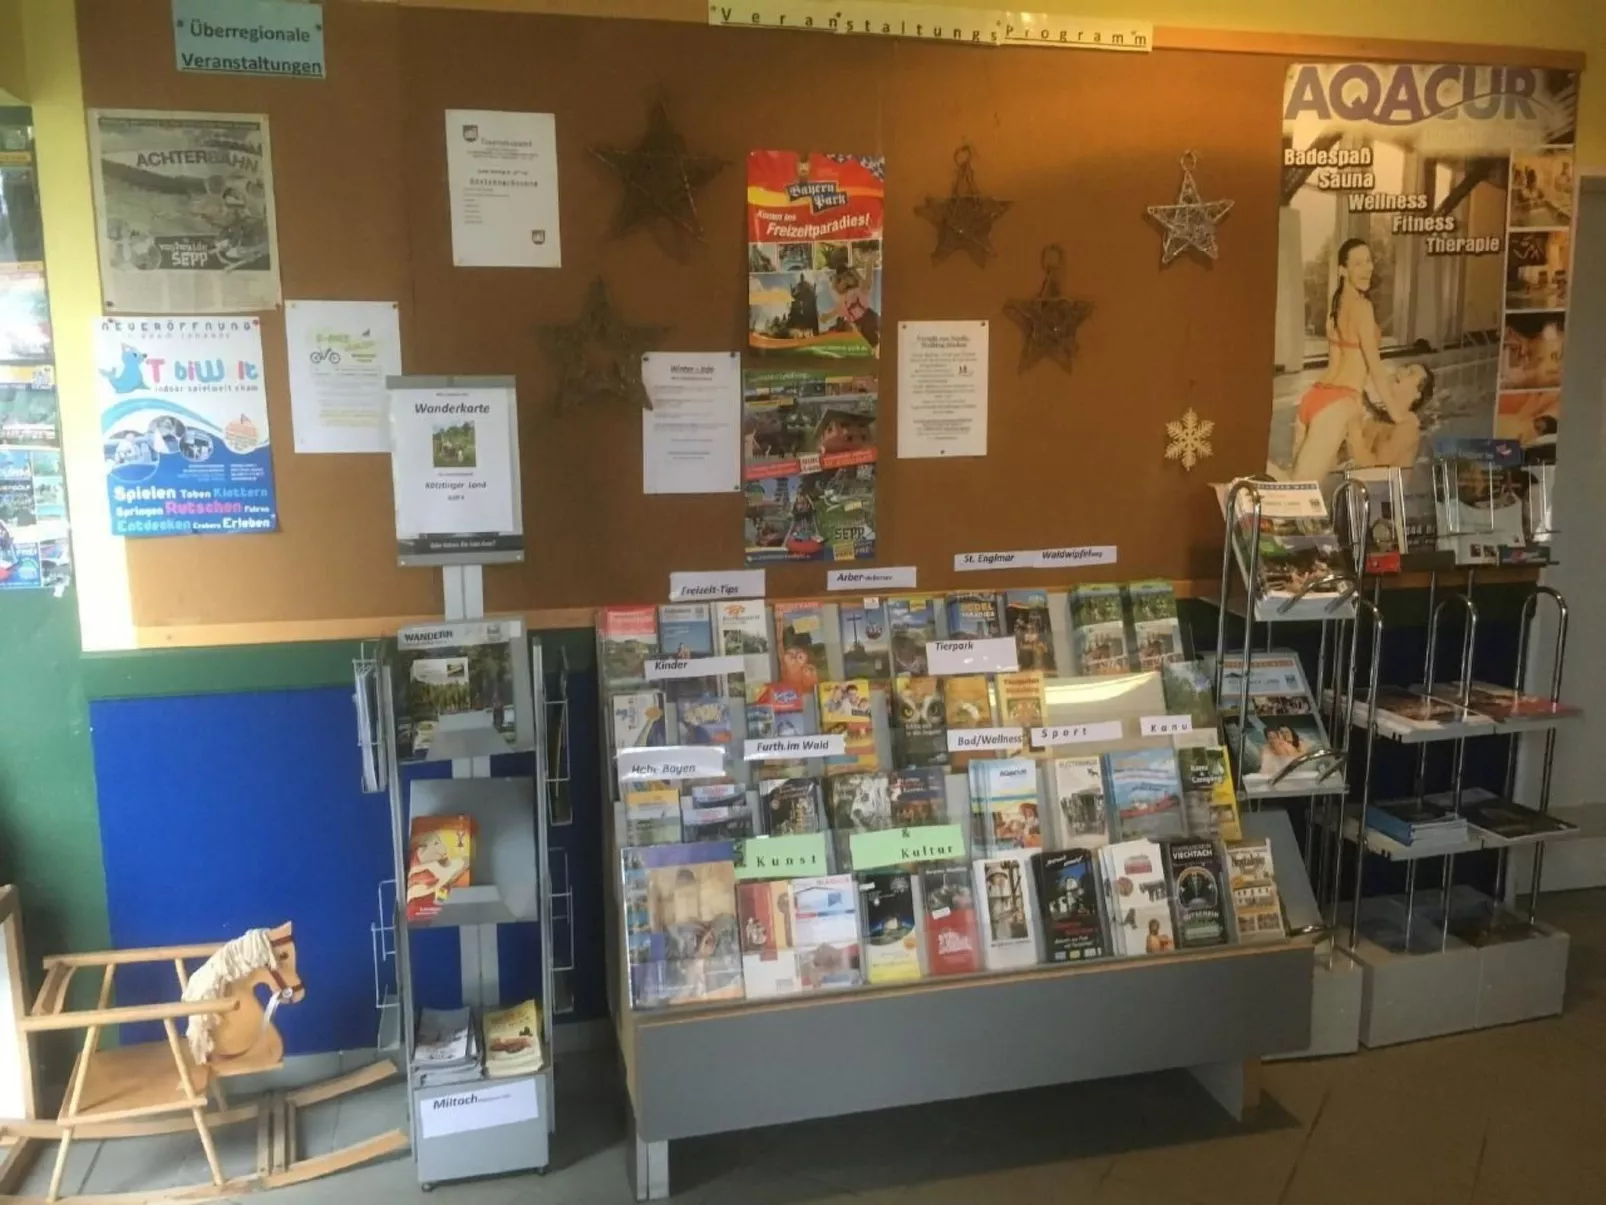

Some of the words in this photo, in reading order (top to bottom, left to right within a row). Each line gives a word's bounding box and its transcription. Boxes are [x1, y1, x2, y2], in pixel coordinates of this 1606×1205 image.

[190, 19, 310, 43] Überregionale
[181, 53, 322, 75] Veranstaltungen
[1284, 63, 1537, 125] AQACUR
[136, 150, 258, 173] ACHTERBAHN
[1284, 149, 1372, 167] Badespaß
[1318, 171, 1374, 189] Sauna
[790, 182, 835, 197] Bayern
[813, 193, 846, 209] Park
[1349, 192, 1428, 211] Wellness
[766, 213, 870, 239] Freizeitparadies!
[1392, 215, 1455, 233] Fitness
[1427, 236, 1500, 254] Therapie
[172, 252, 208, 267] SEPP
[414, 402, 490, 415] Wanderkarte
[113, 485, 177, 503] Spielen
[180, 489, 211, 498] Toben
[213, 487, 268, 497] Klettern
[116, 504, 164, 517] Springen
[164, 500, 242, 515] Rutschen
[116, 519, 192, 532] Entdecken
[222, 517, 271, 529] Erleben
[963, 555, 976, 564] St.
[978, 553, 1015, 564] Englmar
[681, 585, 739, 597] Freizeit-Tips
[404, 630, 453, 642] WANDERN
[935, 641, 974, 652] Tierpark
[654, 660, 688, 671] Kinder
[1041, 726, 1087, 740] Sport
[1150, 723, 1188, 733] Kanu
[802, 739, 829, 751] Wald
[957, 732, 1022, 746] Bad/Wellness
[901, 844, 954, 860] Kultur
[756, 853, 817, 867] Kunst
